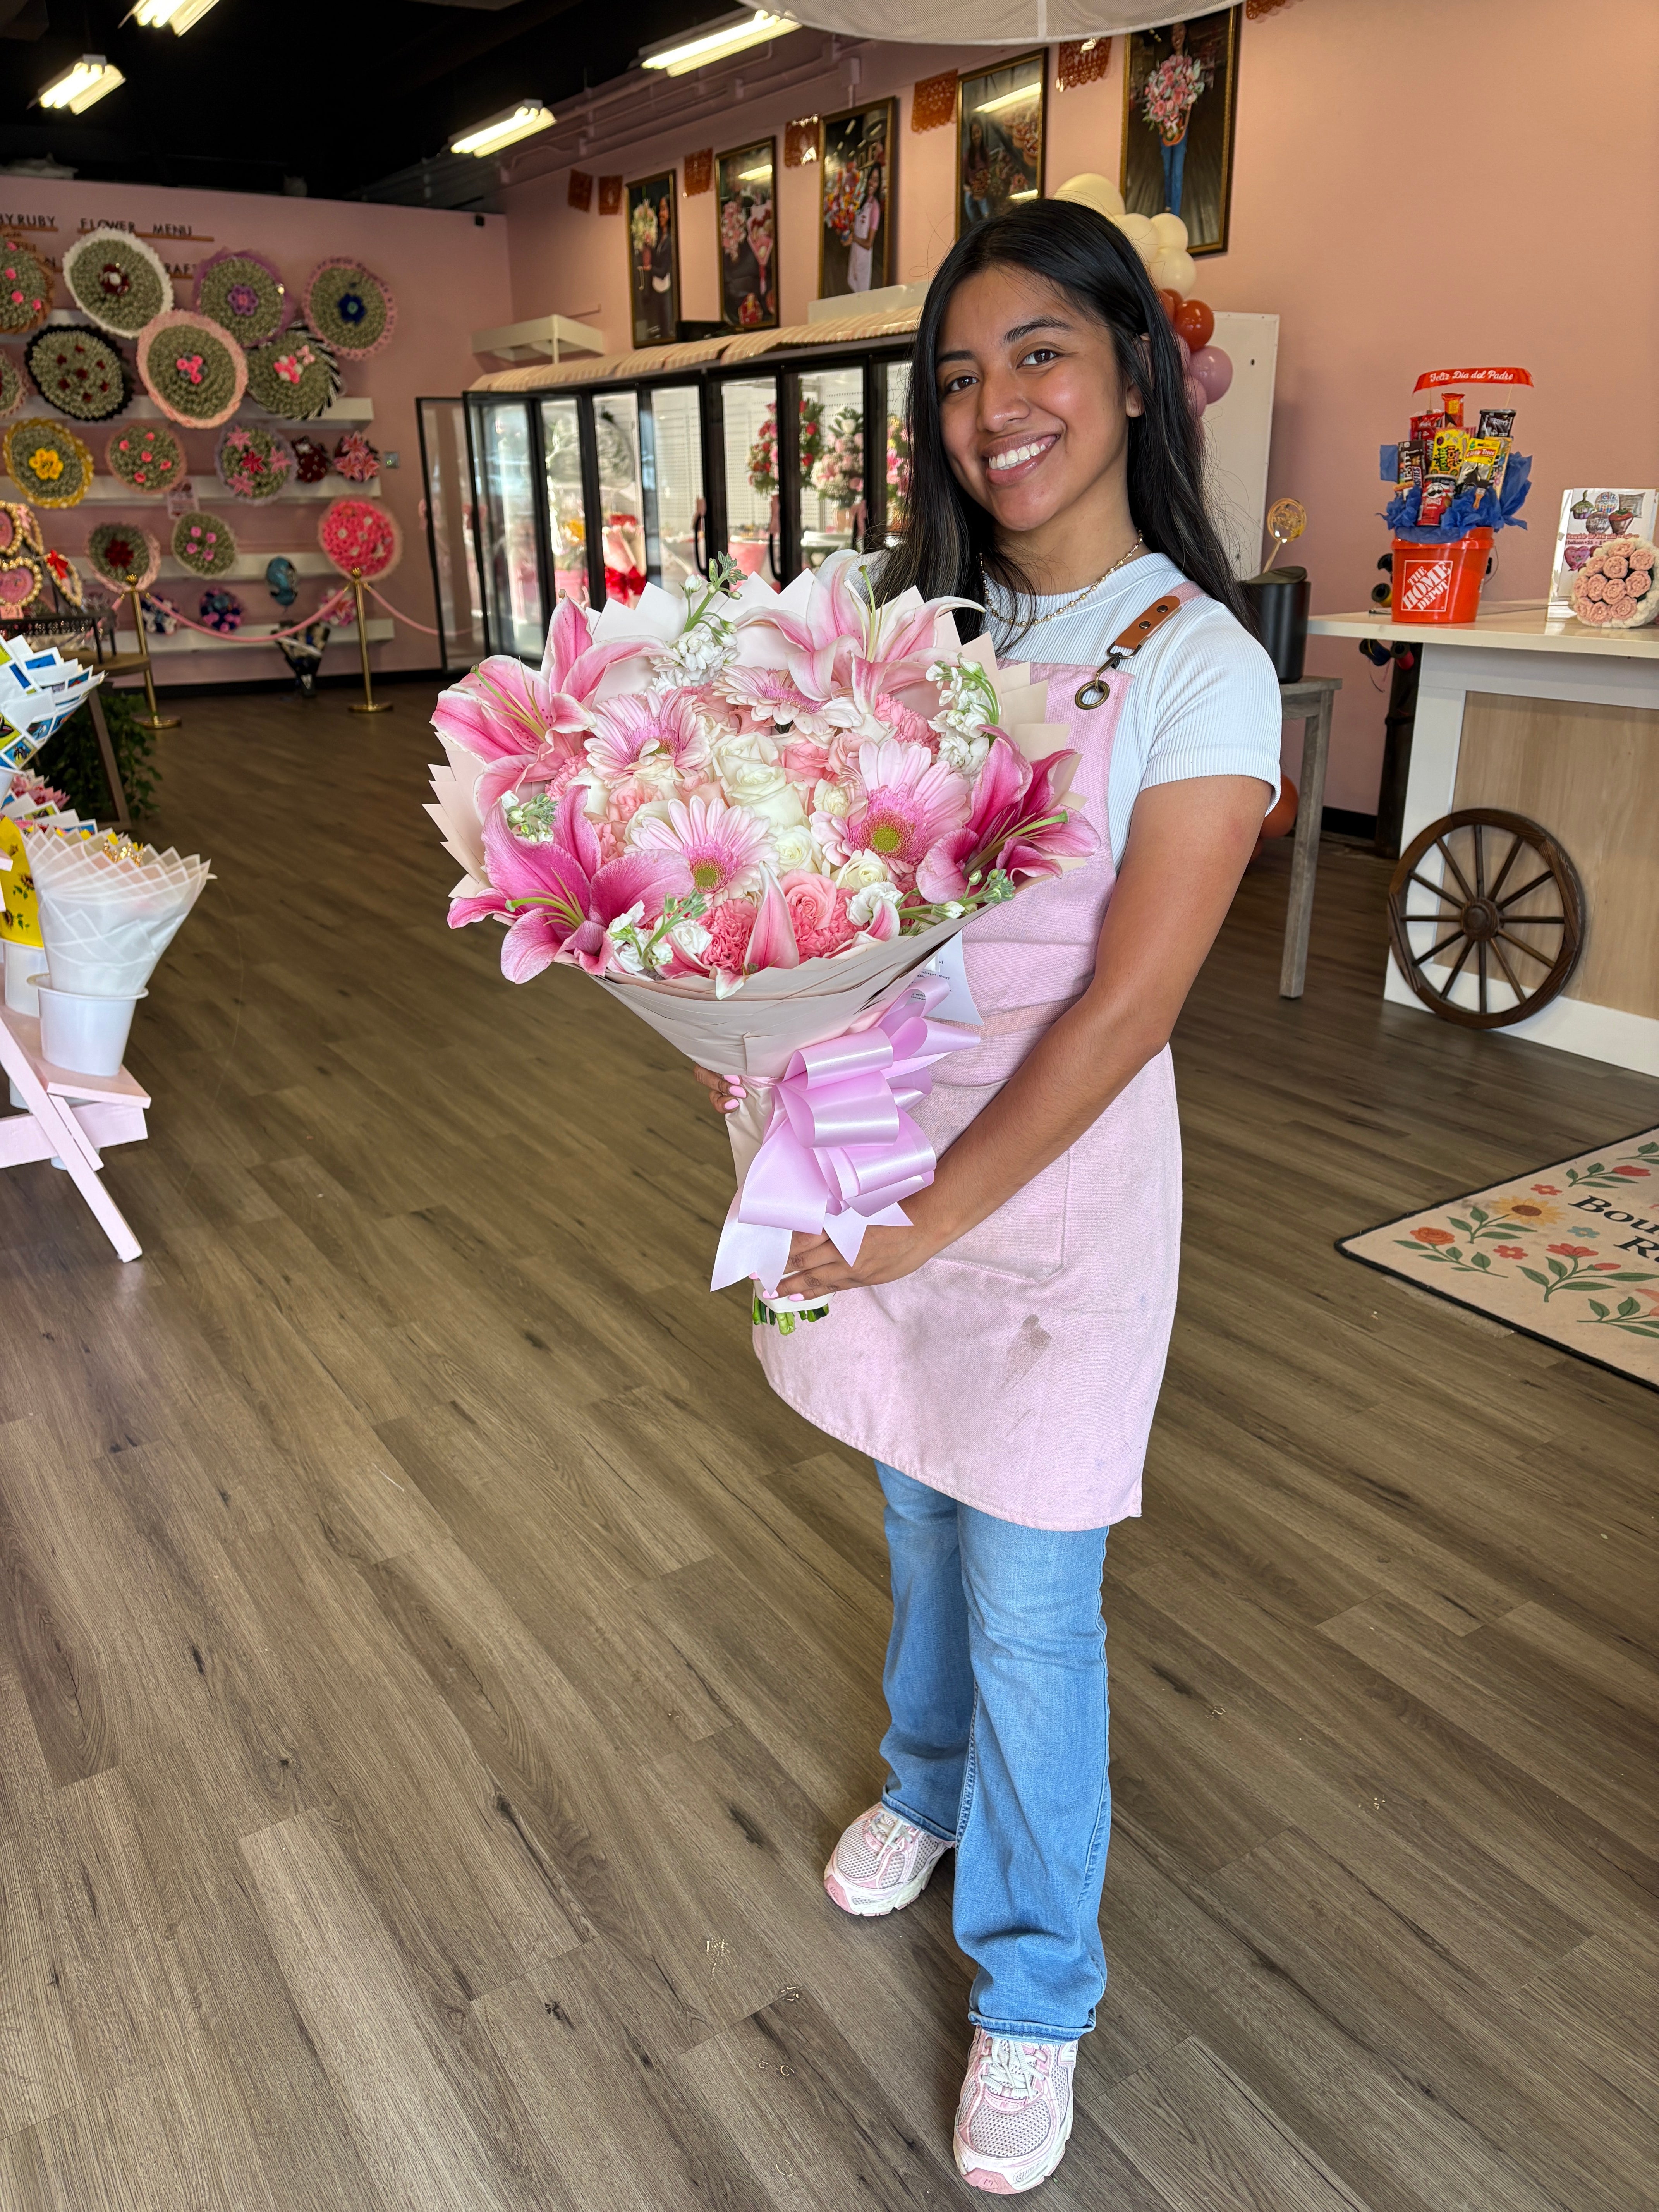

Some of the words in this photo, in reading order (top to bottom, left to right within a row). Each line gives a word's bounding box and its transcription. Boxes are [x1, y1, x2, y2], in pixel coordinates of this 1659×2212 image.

[80, 218, 135, 233] FLOWER
[153, 223, 192, 236] MENU
[1430, 372, 1450, 383] Feliz
[1471, 370, 1487, 379] del
[1487, 370, 1514, 380] Padre
[1403, 562, 1451, 610] HOME
[1407, 566, 1427, 586] THE
[1417, 579, 1448, 610] DEPOT
[1613, 1236, 1659, 1262] R
